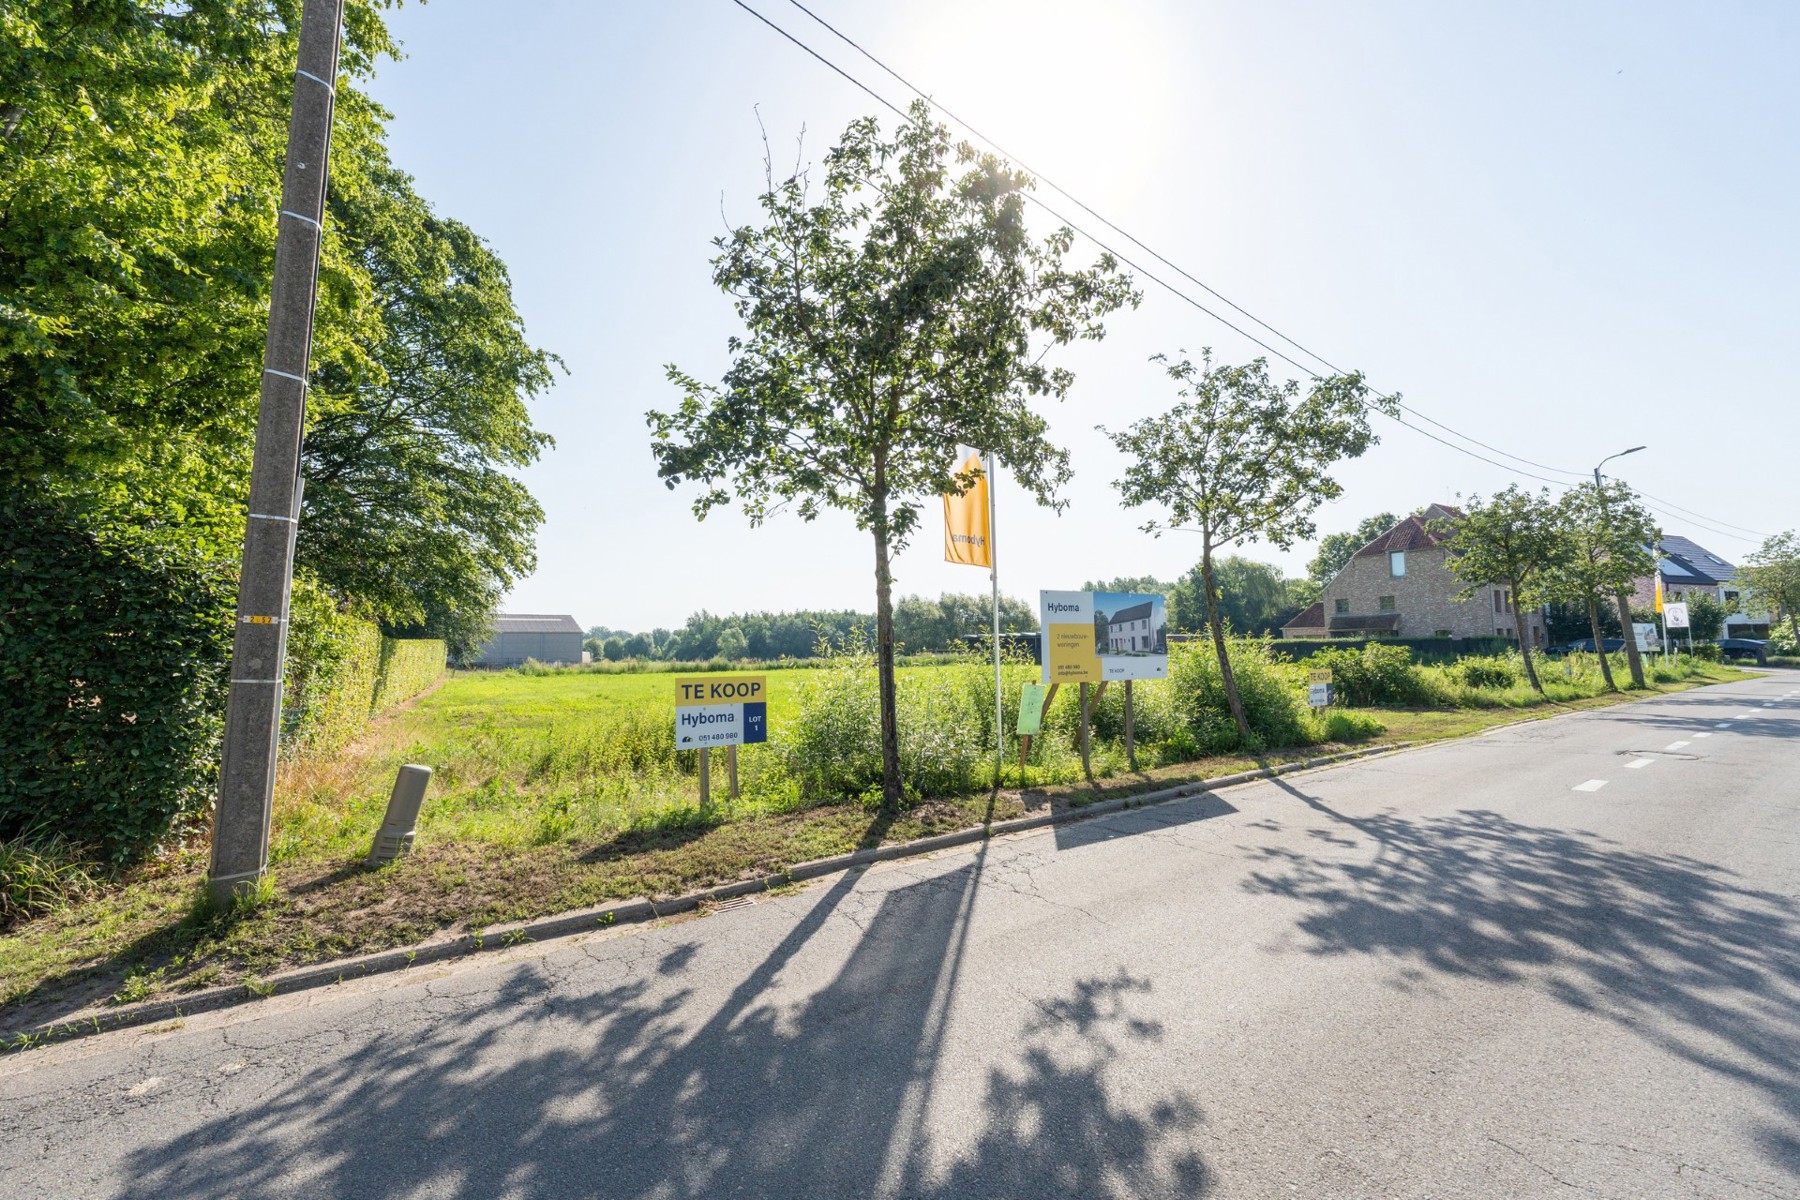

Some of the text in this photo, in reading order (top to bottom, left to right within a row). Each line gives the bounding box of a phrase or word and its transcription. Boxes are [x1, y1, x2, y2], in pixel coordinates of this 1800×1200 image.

[1047, 602, 1080, 613] Hyboma
[1310, 672, 1317, 681] TE
[681, 682, 761, 700] TE KOOP
[681, 712, 735, 728] Hyboma
[748, 715, 762, 723] LOT
[711, 733, 725, 741] 480
[725, 732, 738, 740] 980
